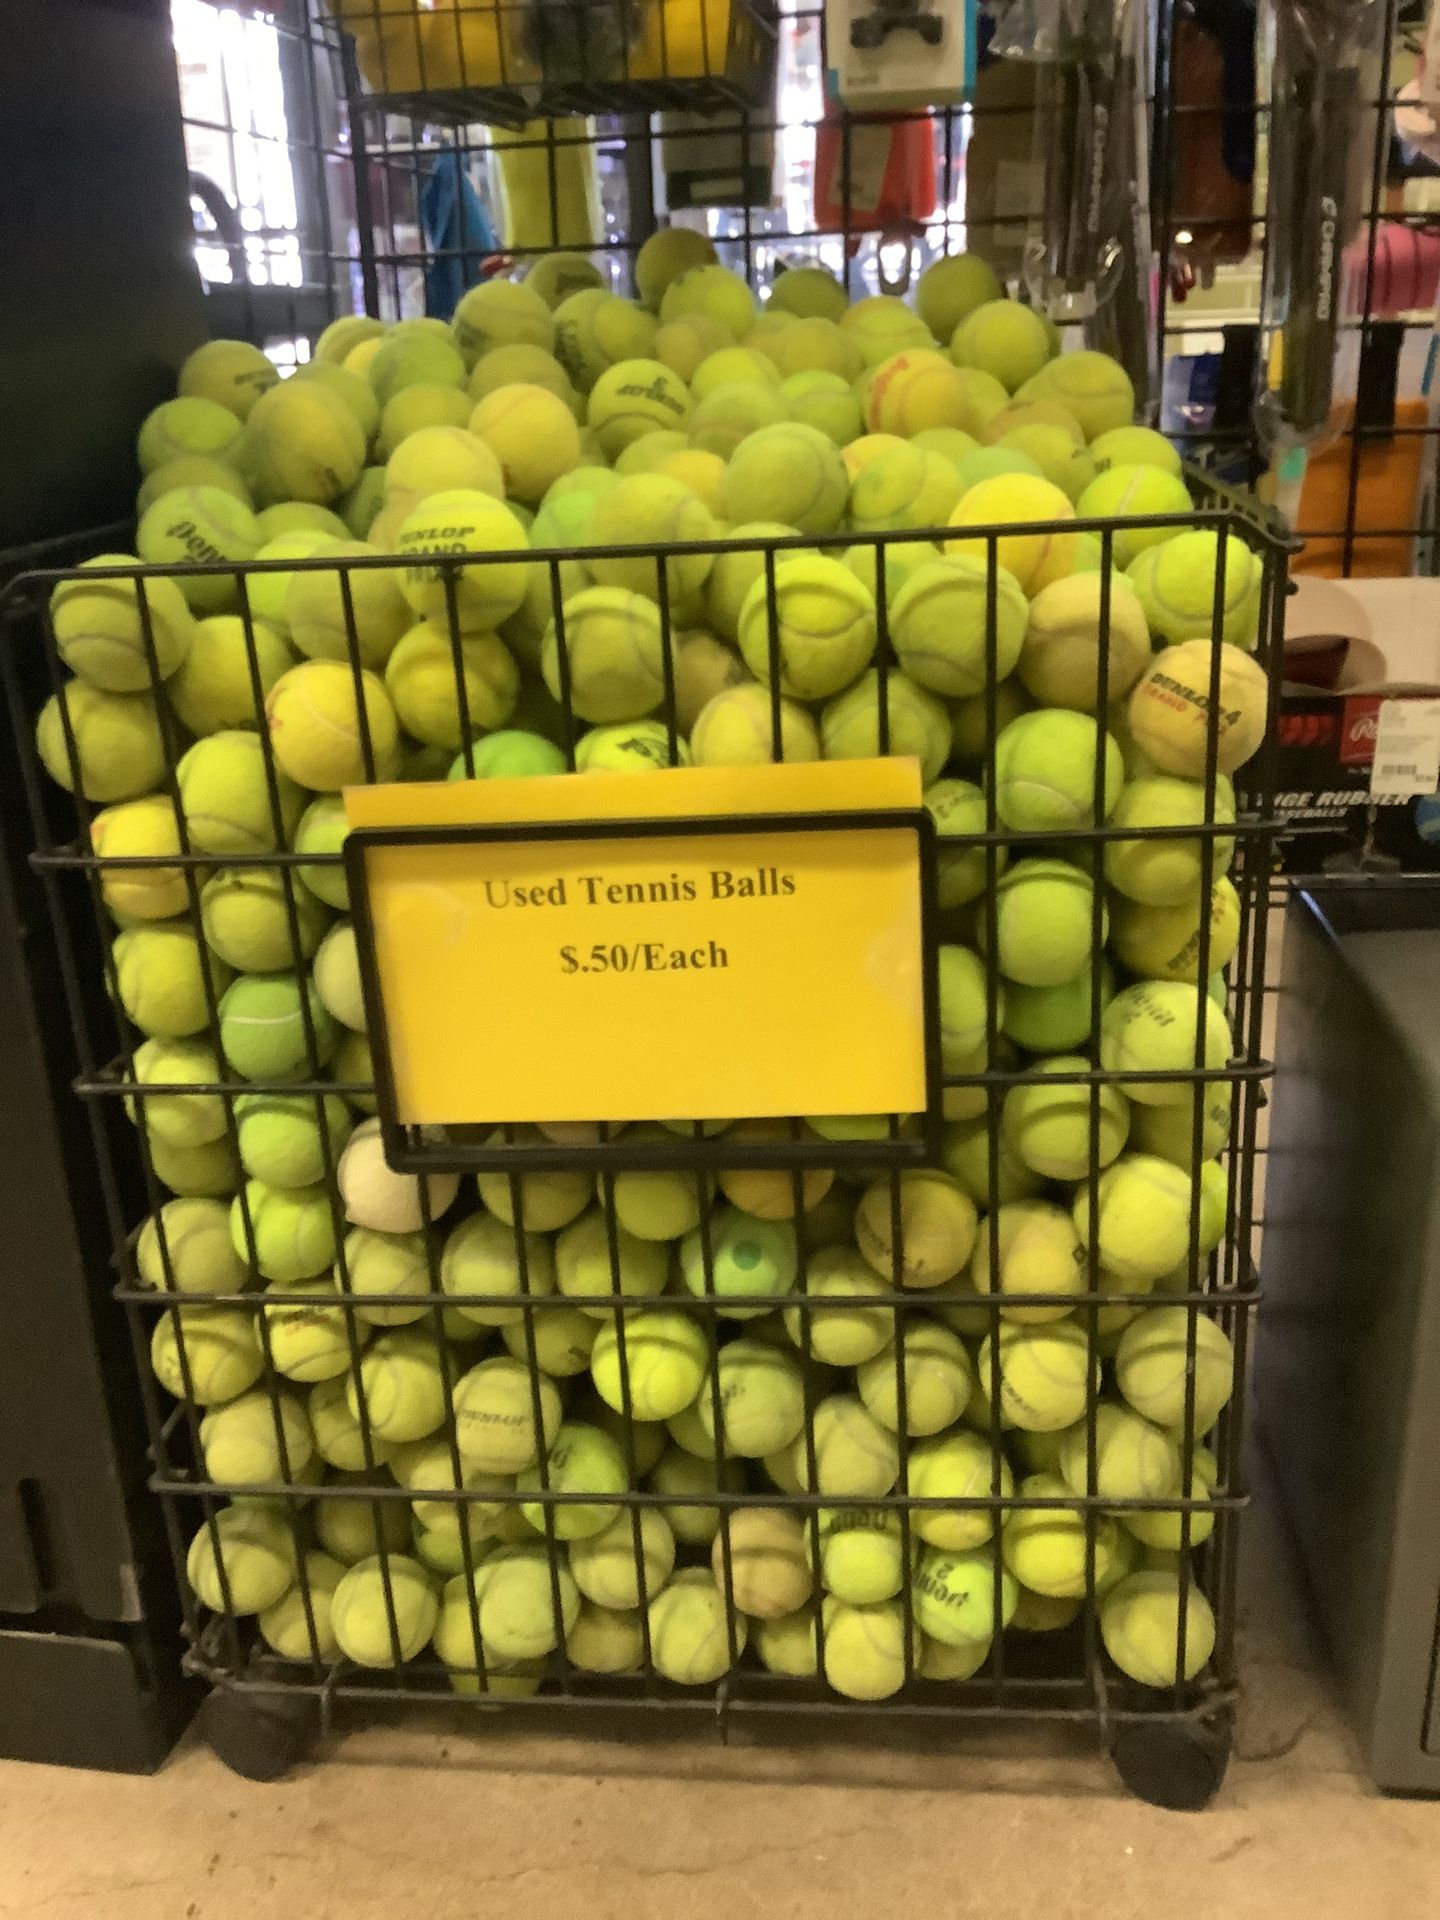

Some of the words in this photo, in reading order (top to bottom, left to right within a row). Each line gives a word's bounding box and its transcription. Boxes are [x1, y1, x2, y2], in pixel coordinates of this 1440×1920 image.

[1151, 672, 1226, 716] DUNLO
[484, 878, 567, 909] Used
[577, 872, 697, 905] Tennis
[709, 867, 796, 899] Balls
[559, 941, 729, 974] $.50/Each
